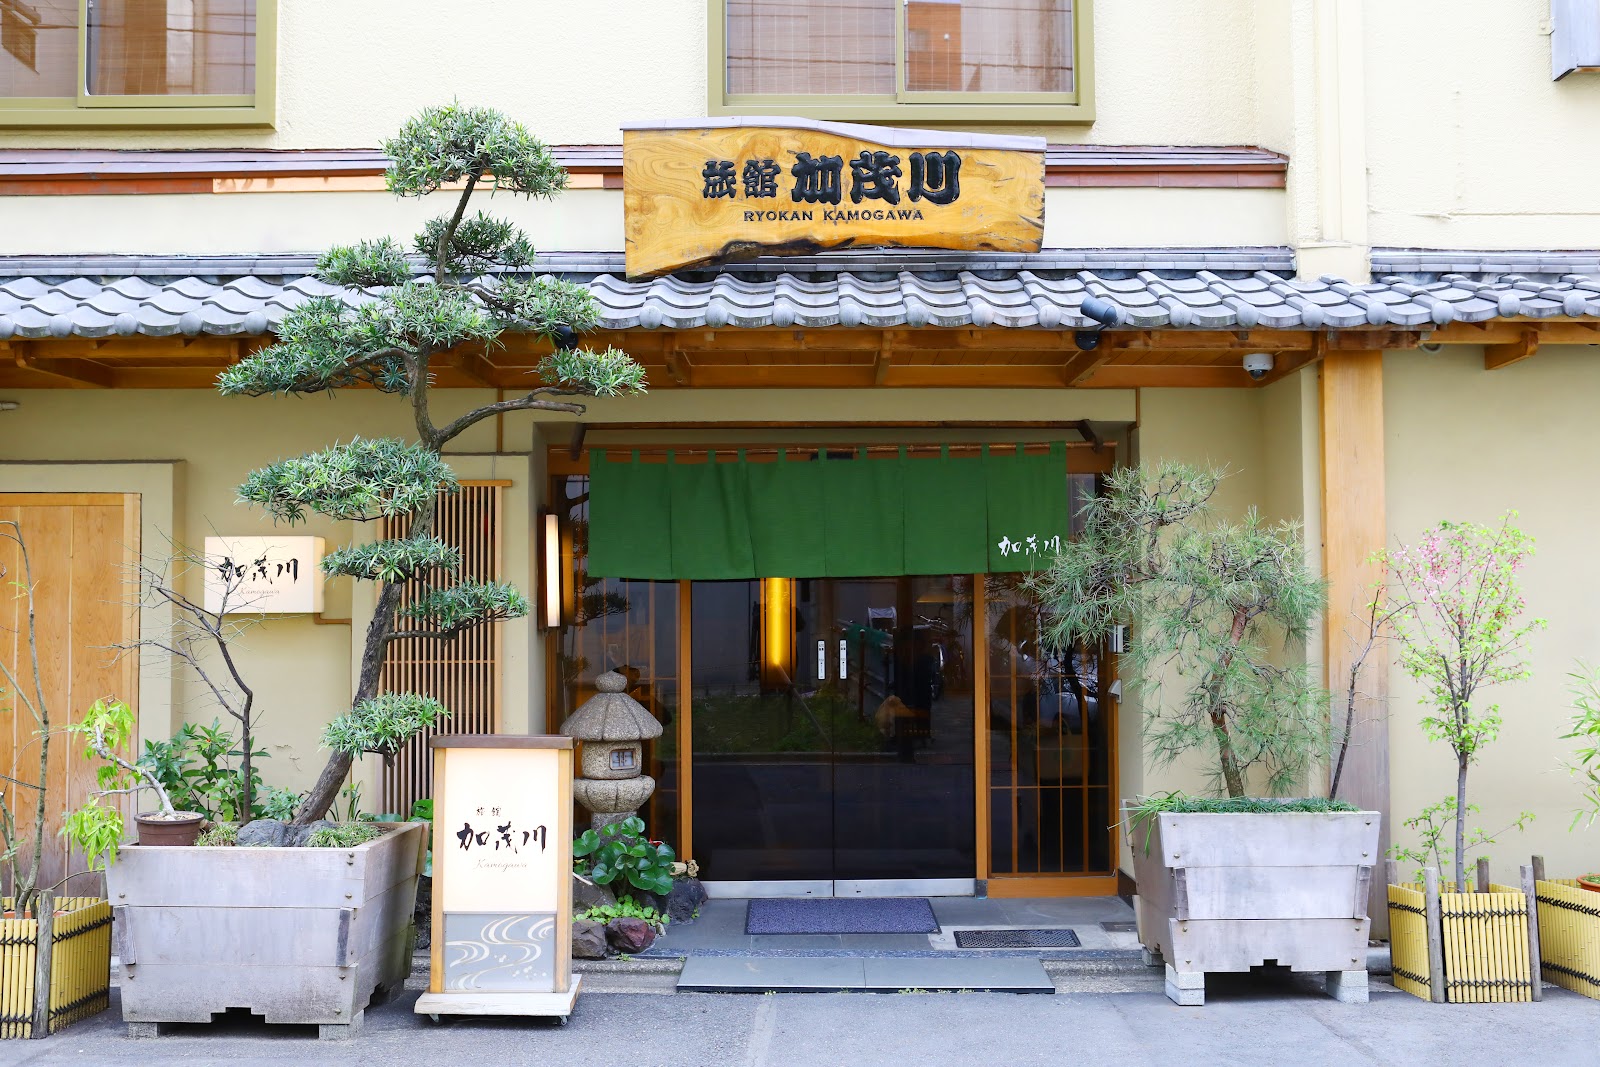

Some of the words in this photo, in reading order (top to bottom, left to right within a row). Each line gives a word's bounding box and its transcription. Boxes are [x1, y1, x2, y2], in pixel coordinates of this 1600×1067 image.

[743, 210, 813, 222] RYOKAN
[823, 209, 925, 222] KAMOGAWA
[998, 533, 1060, 558] 加茂川
[218, 555, 299, 585] 加茂川
[456, 820, 547, 855] 加茂川
